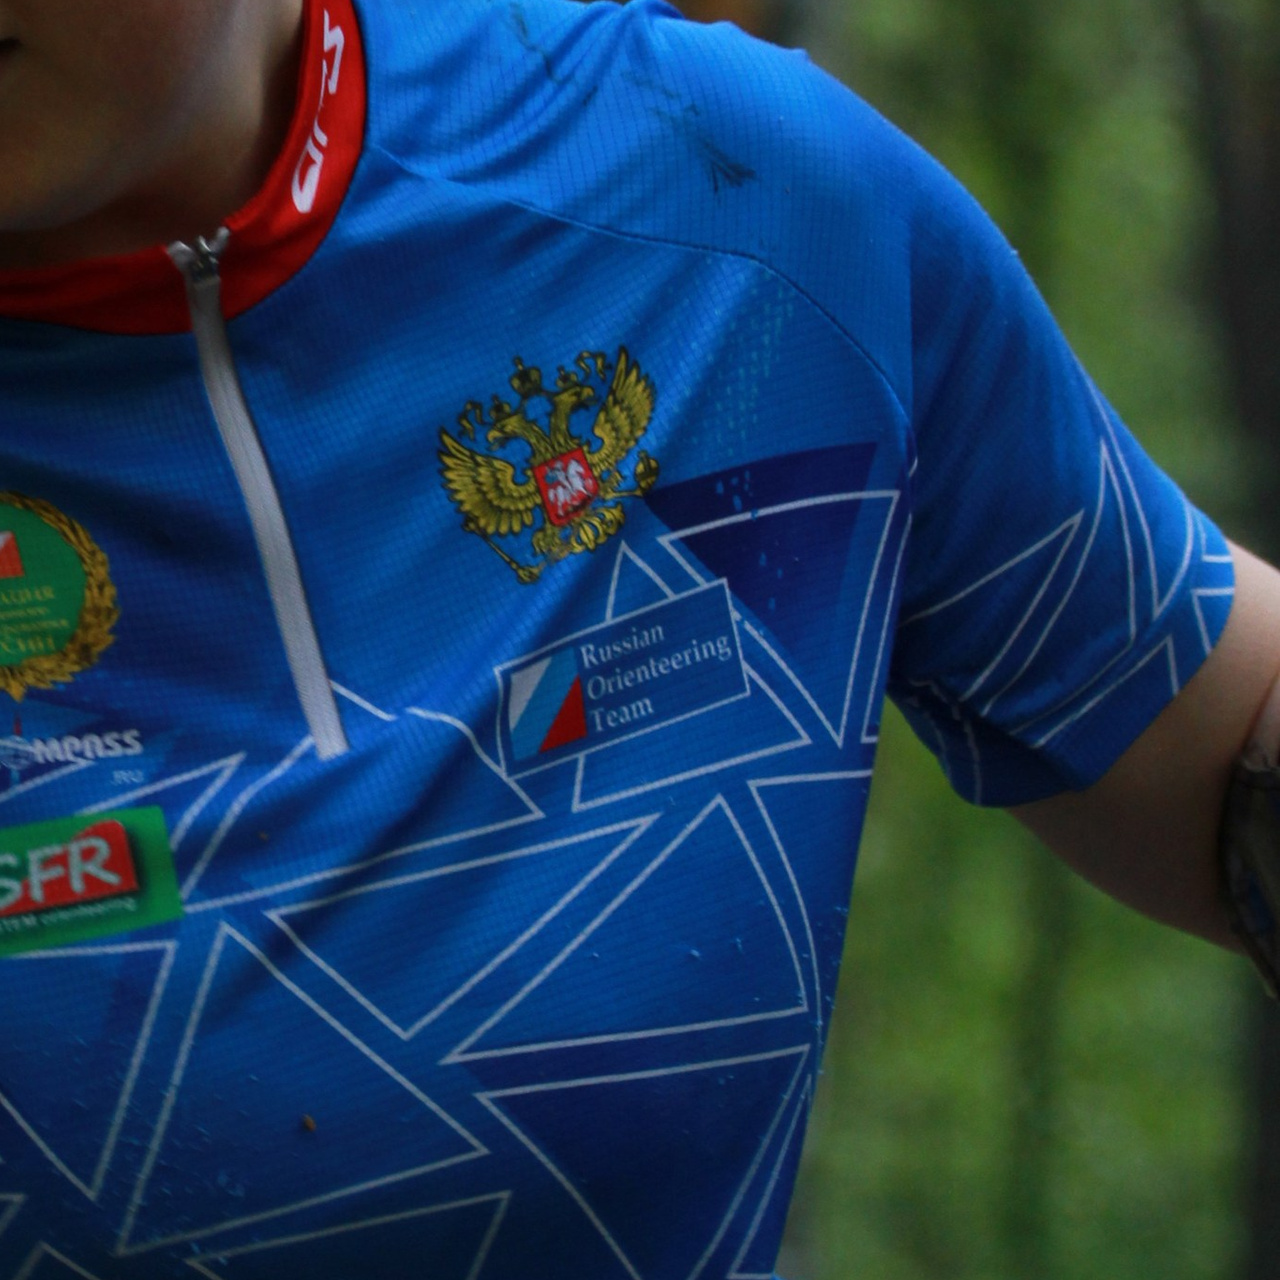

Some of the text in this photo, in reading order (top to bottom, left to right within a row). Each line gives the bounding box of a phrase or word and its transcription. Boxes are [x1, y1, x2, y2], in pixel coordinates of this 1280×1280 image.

[580, 624, 665, 669] Russian
[587, 635, 732, 700] Orienteering
[589, 696, 655, 733] Team
